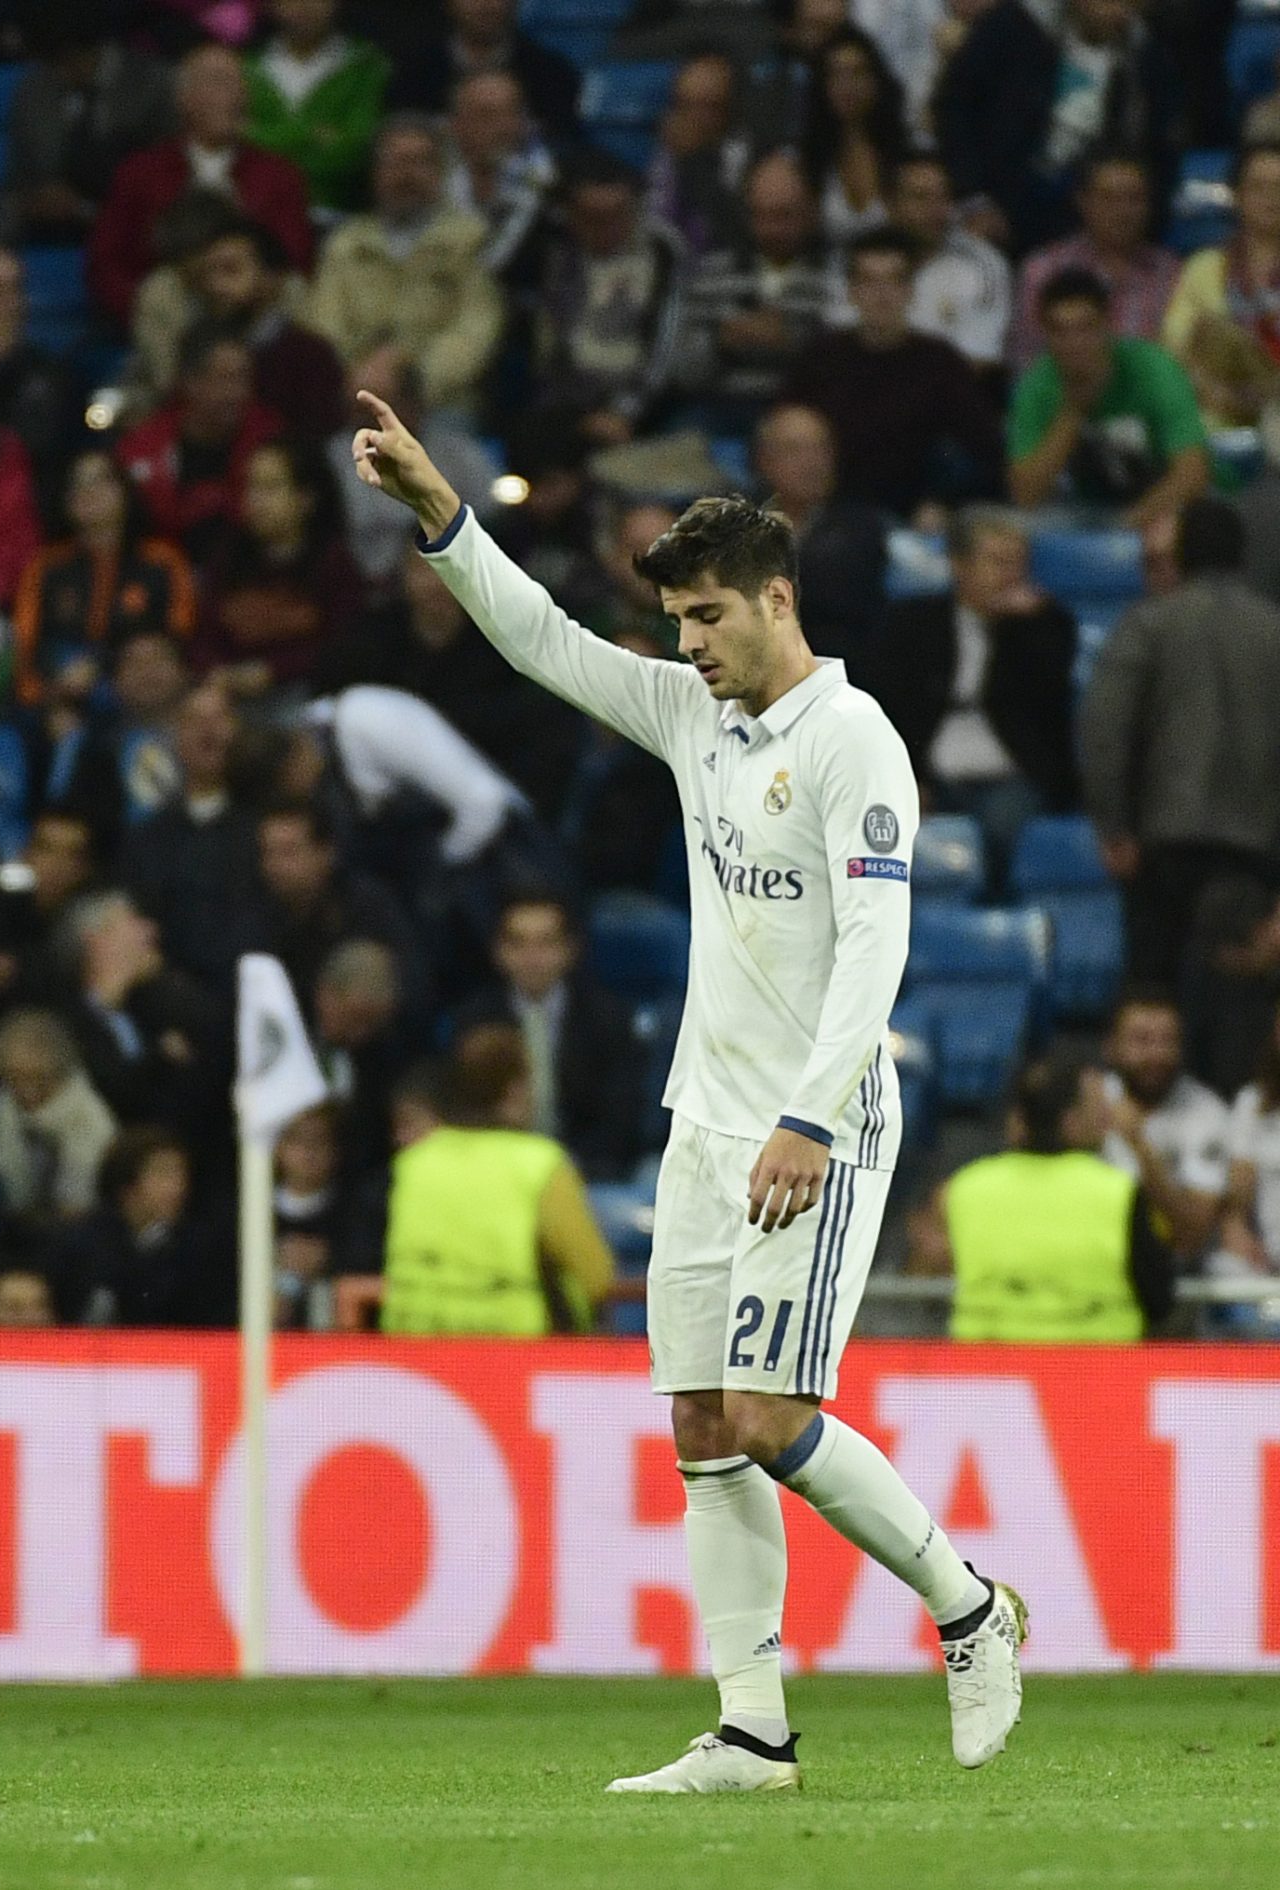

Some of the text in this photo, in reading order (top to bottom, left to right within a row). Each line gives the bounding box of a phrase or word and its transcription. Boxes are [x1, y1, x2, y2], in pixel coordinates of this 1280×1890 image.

[874, 827, 890, 842] 11
[865, 862, 907, 876] RESPECT
[728, 1294, 794, 1372] 21
